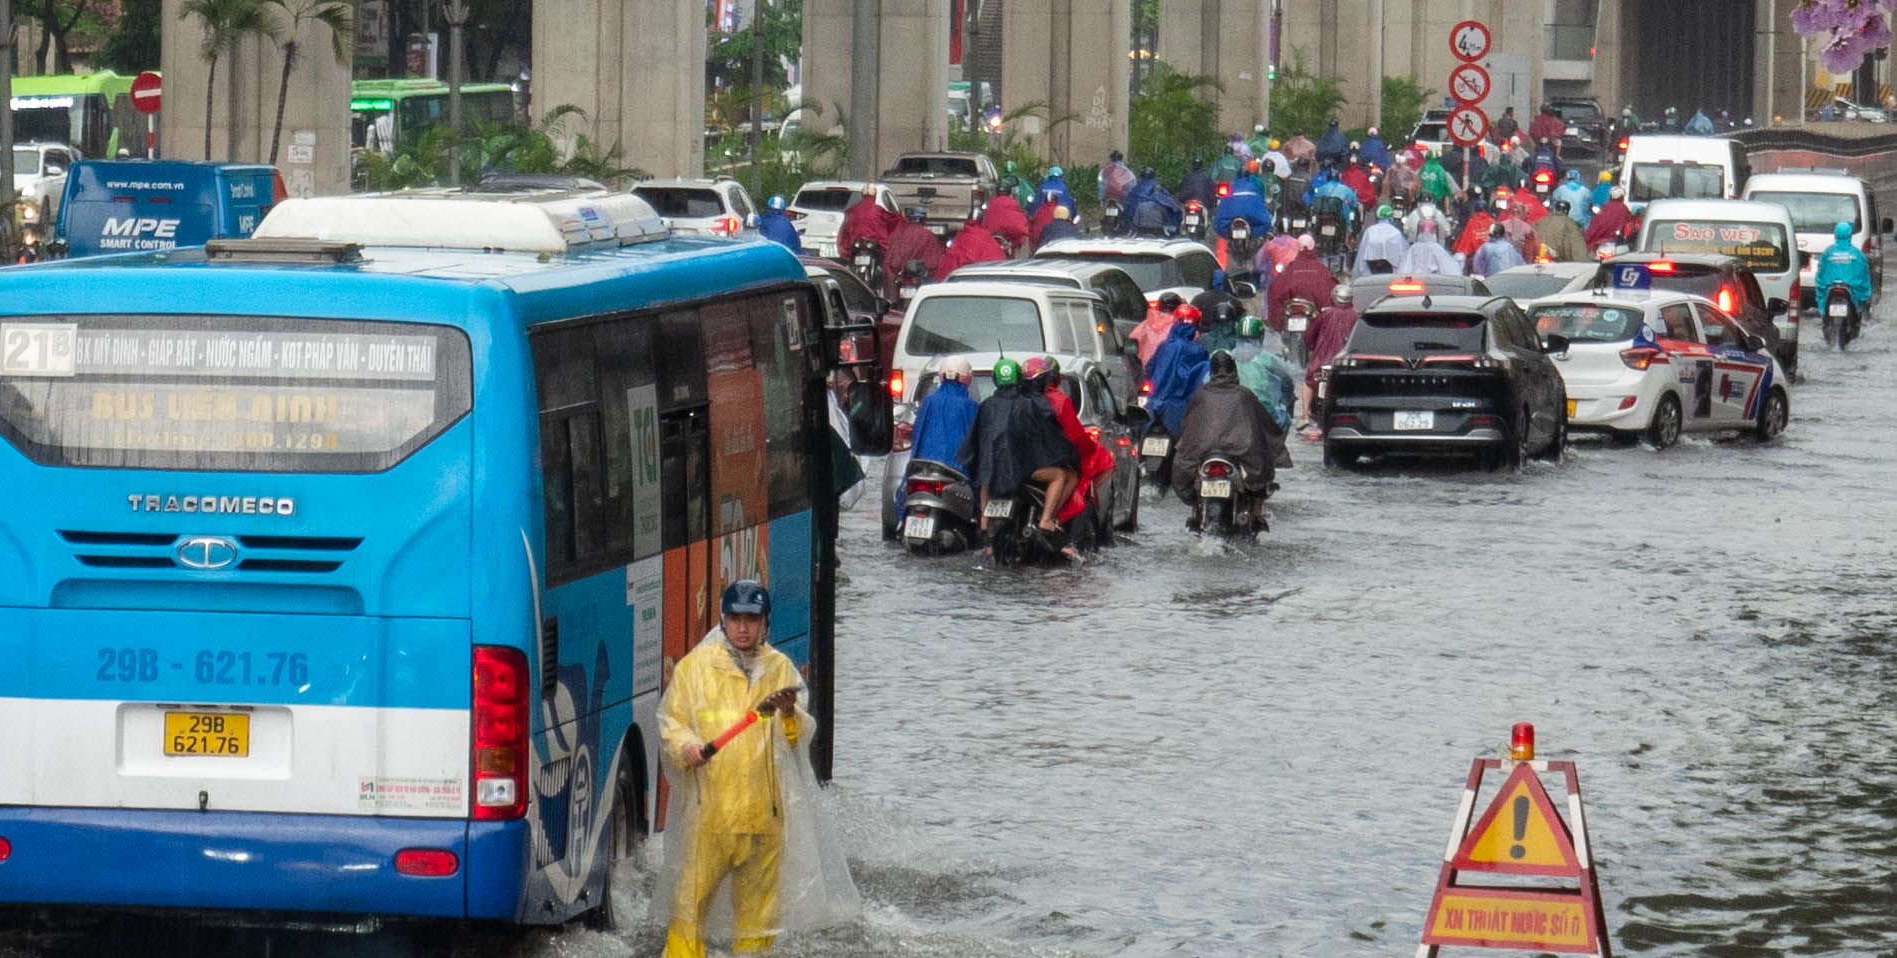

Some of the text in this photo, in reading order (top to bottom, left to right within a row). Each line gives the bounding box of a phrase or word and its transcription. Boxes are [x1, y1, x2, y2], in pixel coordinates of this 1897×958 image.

[107, 181, 184, 191] www.mpe.com.vn
[102, 218, 181, 237] MPE
[1674, 223, 1715, 241] SAO
[100, 239, 131, 249] SMART
[1622, 267, 1640, 287] G7
[77, 337, 91, 365] BX
[148, 335, 174, 366] GIÁP
[176, 334, 197, 367] BÁT
[206, 334, 236, 368] NƯỚC
[305, 339, 333, 371] PHÁP
[336, 338, 358, 371] VÂN
[368, 339, 403, 373] DUYÊN
[407, 340, 431, 374] THÁI
[93, 391, 154, 420] BUS
[128, 494, 295, 516] TRACOMECO
[96, 649, 309, 687] 29B 621.76
[189, 716, 225, 733] 29B
[174, 736, 239, 753] 621.76
